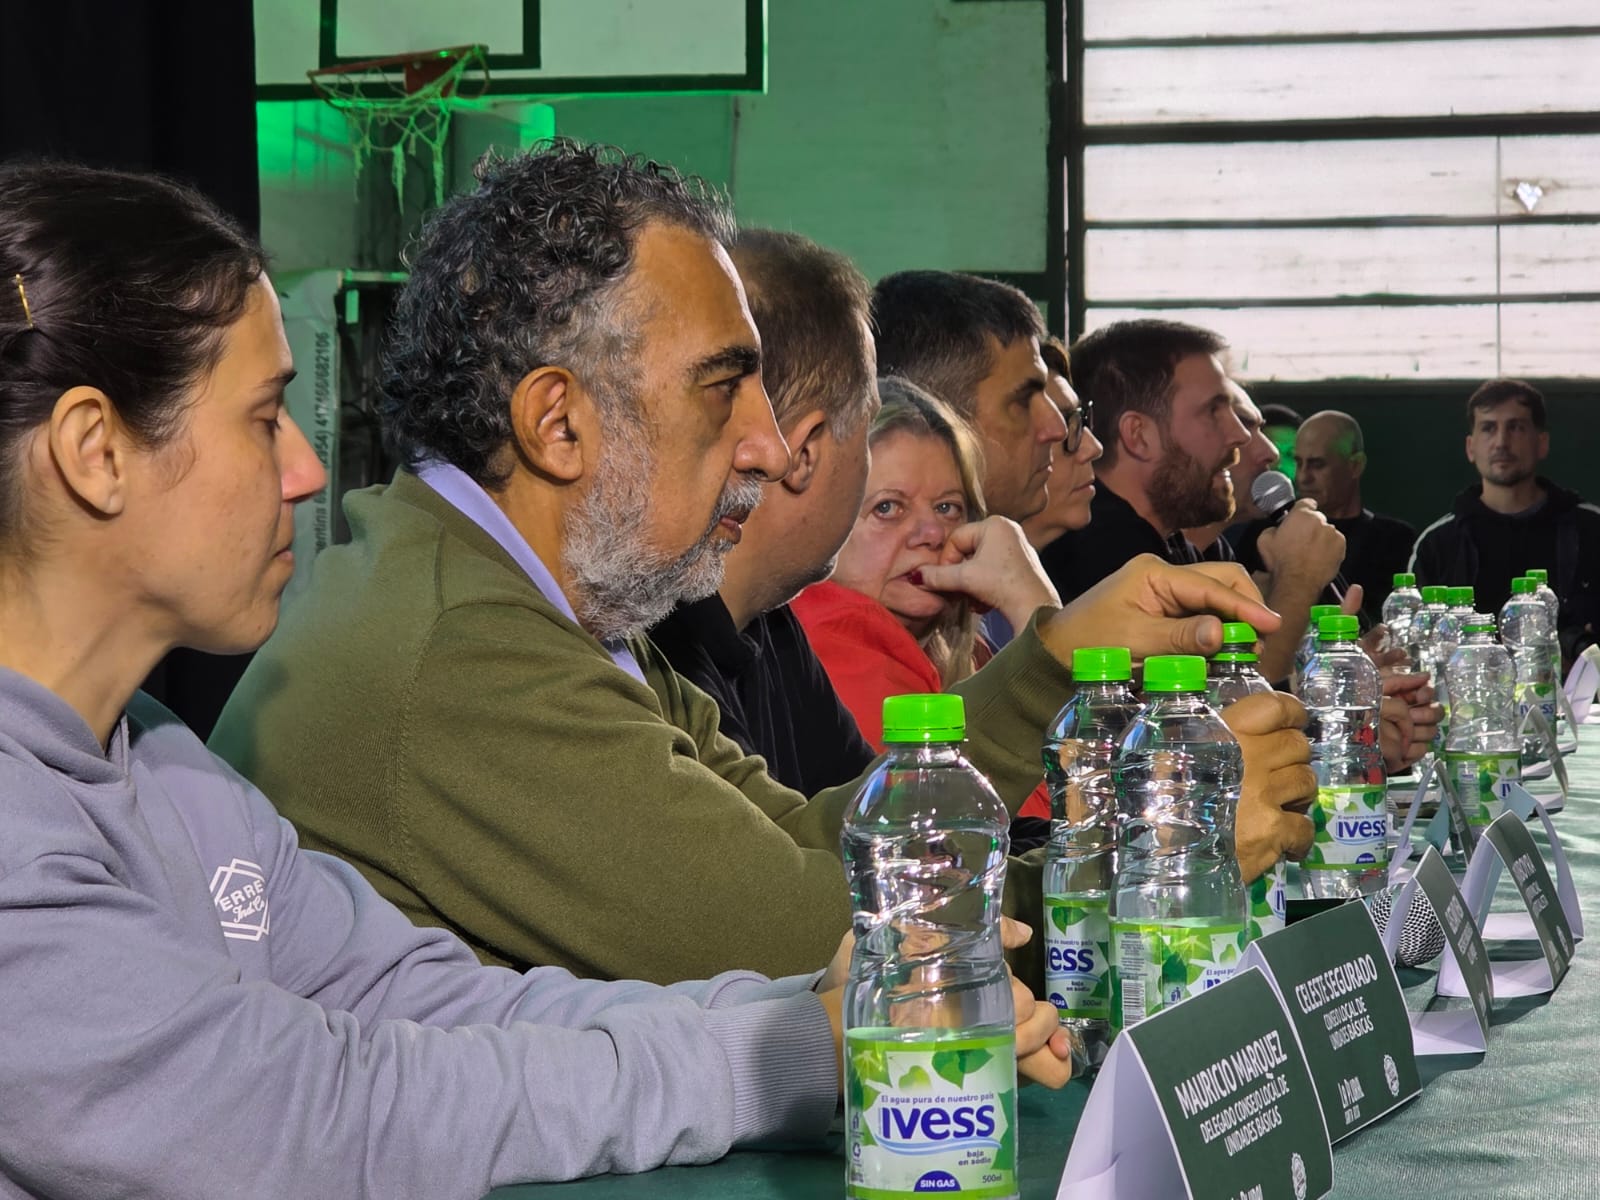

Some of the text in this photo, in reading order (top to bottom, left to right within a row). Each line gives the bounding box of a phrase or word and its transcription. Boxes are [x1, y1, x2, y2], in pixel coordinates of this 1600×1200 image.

[220, 880, 264, 912] ERRE
[1046, 946, 1094, 973] ess
[1295, 953, 1378, 1014] CELESTE SEGURADO
[1339, 1001, 1359, 1022] LOCAL
[1355, 996, 1367, 1014] DE
[1174, 1030, 1287, 1119] MAURICIO MARQUEZ
[881, 1095, 888, 1103] El
[890, 1096, 910, 1105] agua
[912, 1096, 932, 1105] pura
[935, 1095, 945, 1103] de
[948, 1094, 978, 1103] nuestro
[1200, 1074, 1290, 1143] DELEGADO CONSEJO LOCAL DE
[1224, 1105, 1282, 1156] UNIDADES BÁSICAS
[920, 1179, 956, 1188] SIN GAS
